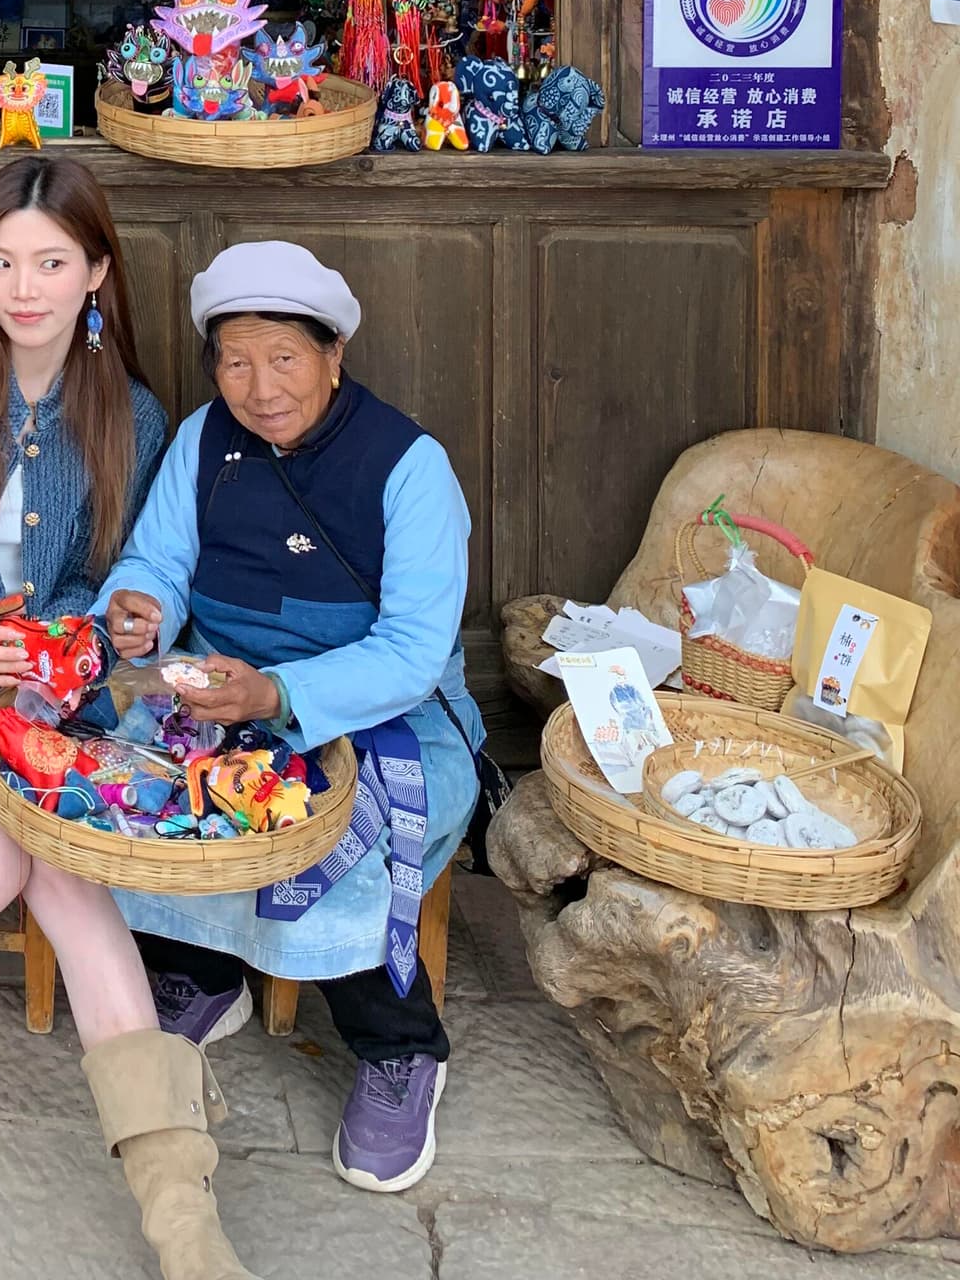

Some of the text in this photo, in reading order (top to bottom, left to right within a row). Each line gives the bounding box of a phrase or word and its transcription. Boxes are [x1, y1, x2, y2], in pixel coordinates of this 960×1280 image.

[667, 87, 817, 105] 诚信经营 放心消费
[696, 108, 788, 129] 承诺店
